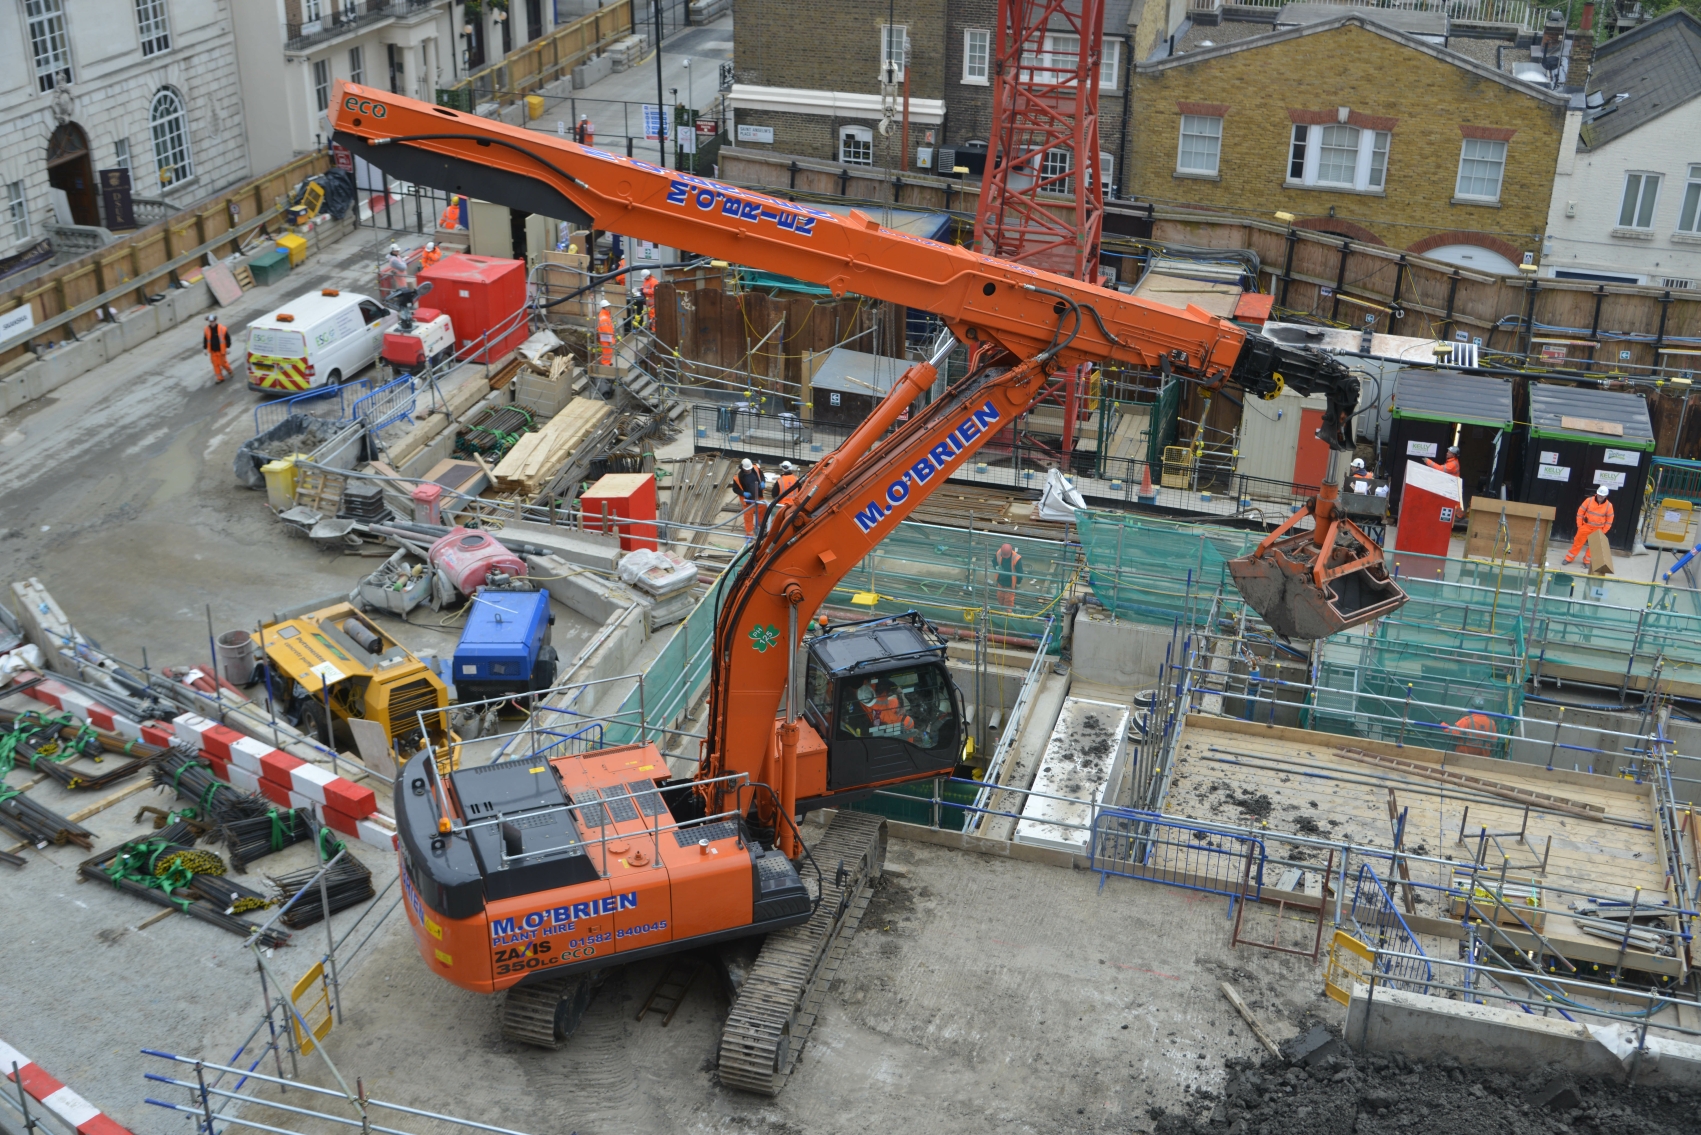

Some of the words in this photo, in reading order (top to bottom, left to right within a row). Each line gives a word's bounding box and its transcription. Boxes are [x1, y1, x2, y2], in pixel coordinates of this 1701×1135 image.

[345, 96, 387, 119] eco
[666, 180, 817, 237] M.O'BRIEN
[853, 400, 1000, 534] M.O'BRIEN
[752, 627, 763, 638] PH
[760, 631, 773, 644] 125
[491, 891, 638, 938] M.O'BRIEN
[492, 929, 538, 948] PLANT
[543, 922, 576, 937] HIRE
[569, 932, 613, 949] 01582
[616, 920, 668, 938] 840045
[495, 940, 552, 963] ZAXIS
[561, 946, 597, 962] eco
